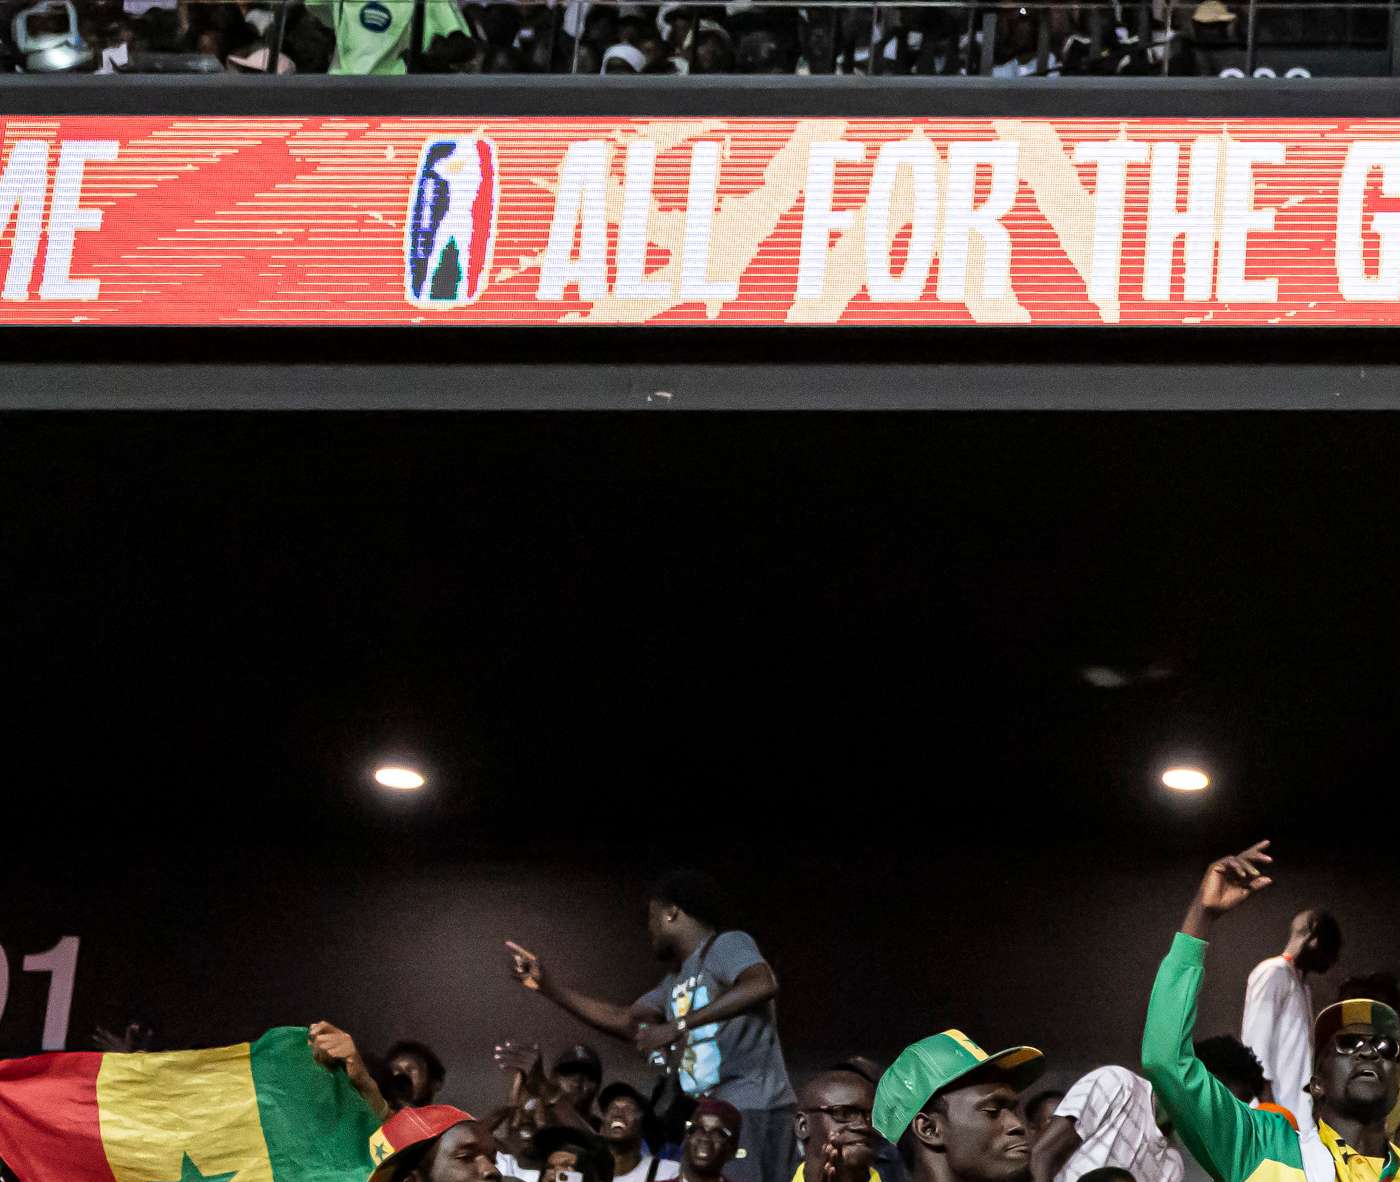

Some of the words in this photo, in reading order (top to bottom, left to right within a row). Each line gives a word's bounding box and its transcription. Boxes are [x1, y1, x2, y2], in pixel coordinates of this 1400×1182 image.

[535, 139, 739, 301] ALL
[794, 140, 1019, 301] FOR
[1074, 140, 1286, 302] THE
[0, 935, 80, 1050] 1
